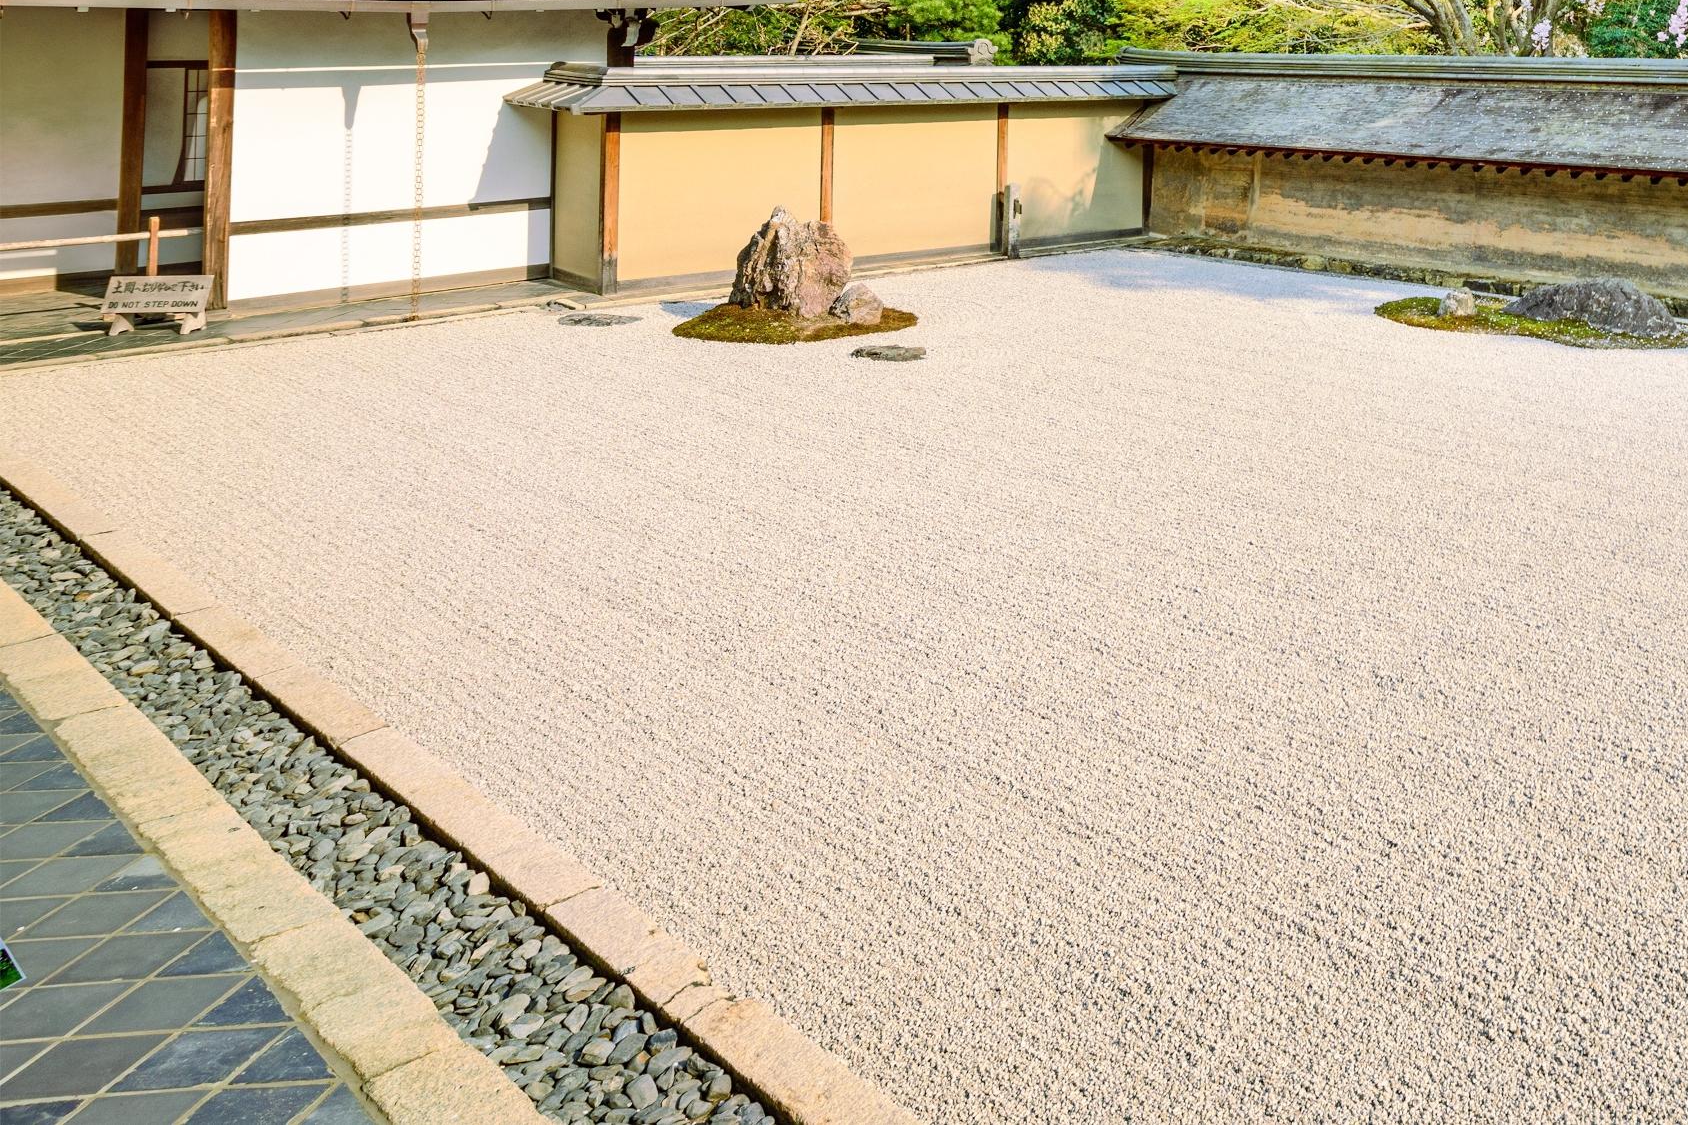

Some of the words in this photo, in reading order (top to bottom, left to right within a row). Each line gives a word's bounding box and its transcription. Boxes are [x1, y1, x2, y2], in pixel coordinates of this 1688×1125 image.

[108, 301, 119, 309] DO
[121, 301, 141, 309] NOT
[144, 300, 170, 308] STEP
[171, 300, 199, 308] DOWN
